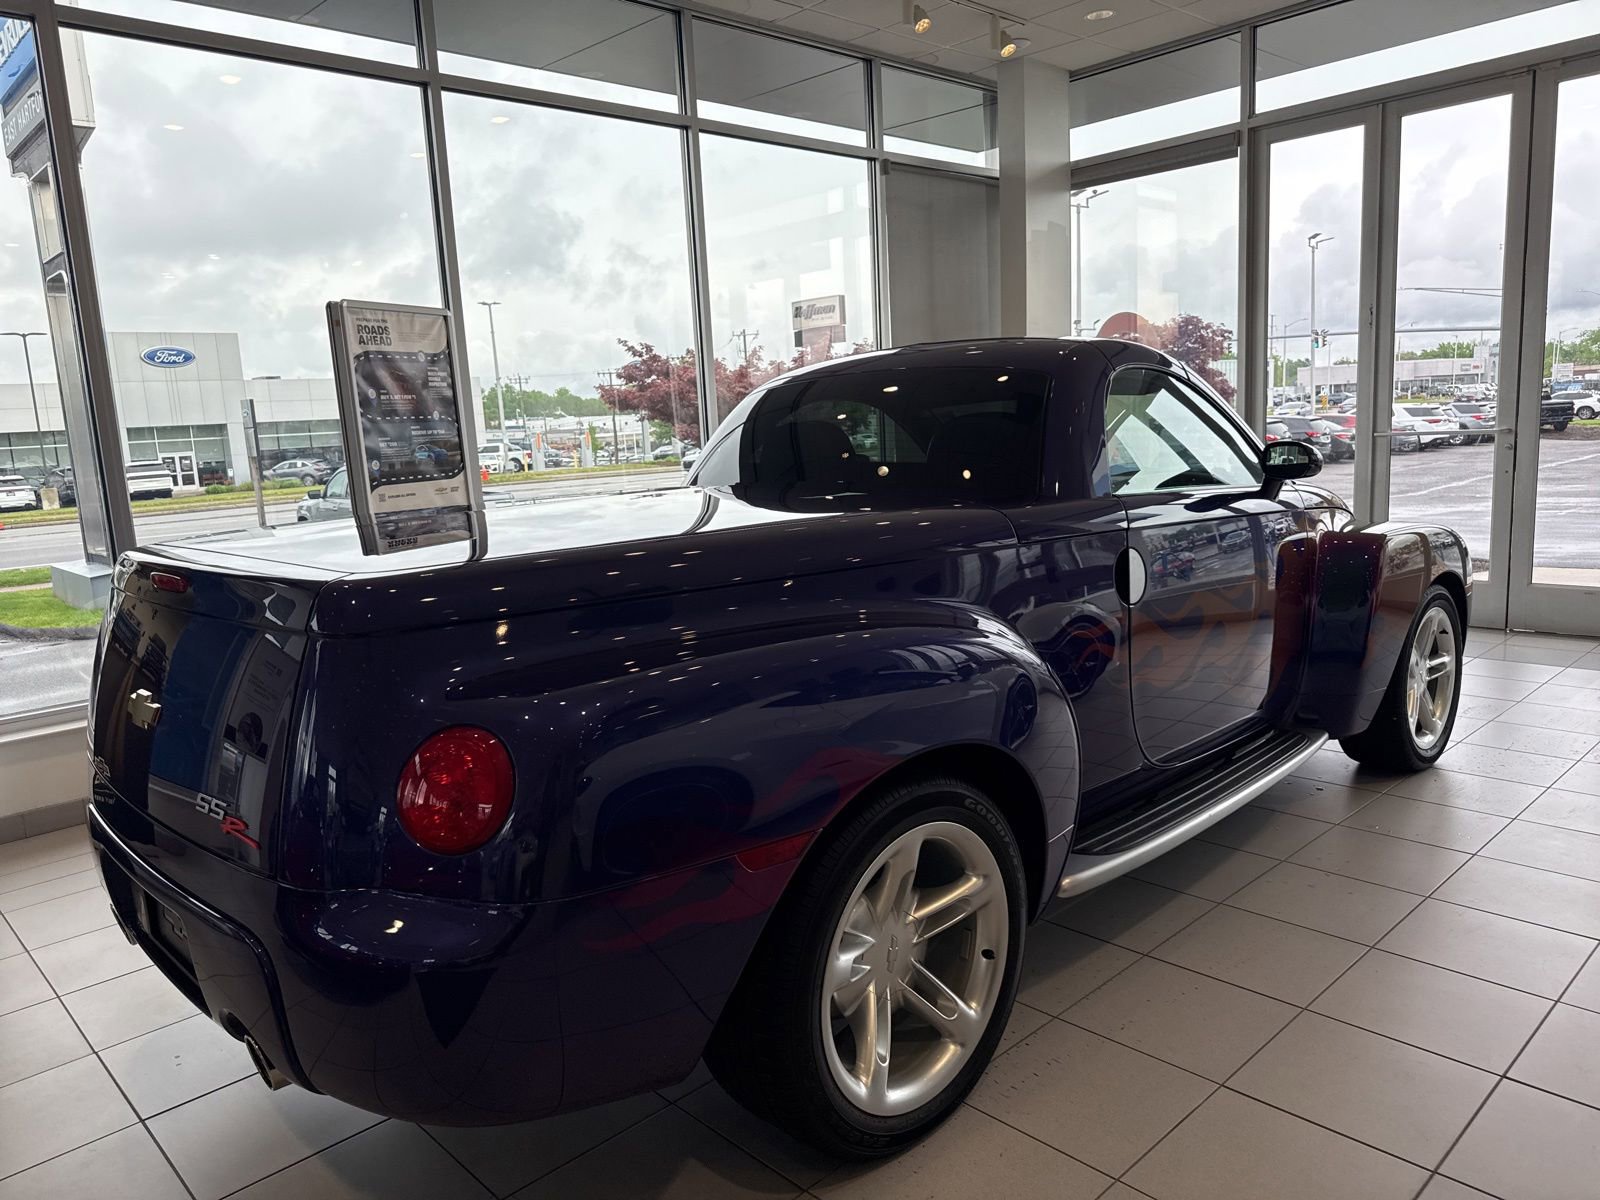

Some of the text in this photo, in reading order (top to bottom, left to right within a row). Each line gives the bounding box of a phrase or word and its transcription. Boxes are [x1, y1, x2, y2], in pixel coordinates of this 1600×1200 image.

[4, 117, 17, 146] EAST
[356, 324, 391, 336] ROADS
[358, 335, 392, 346] AHEAD
[154, 350, 185, 363] Ford
